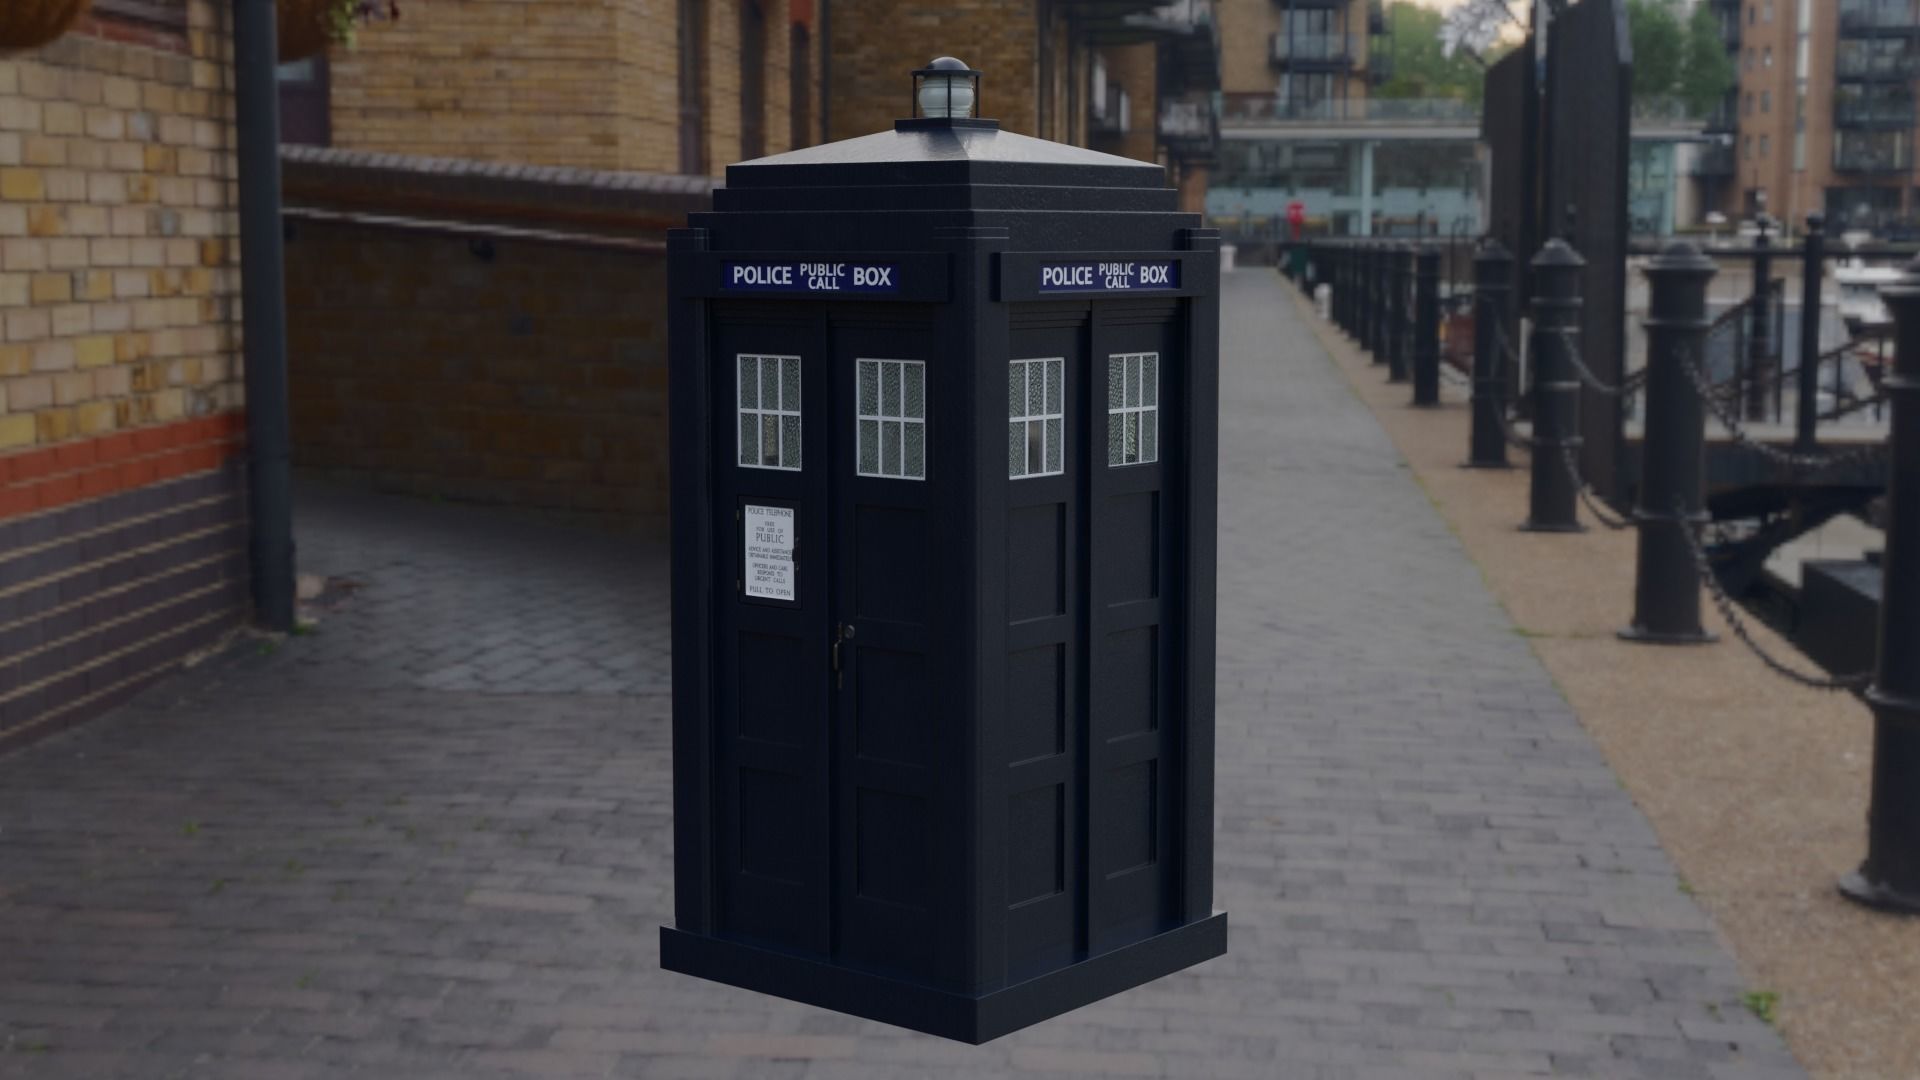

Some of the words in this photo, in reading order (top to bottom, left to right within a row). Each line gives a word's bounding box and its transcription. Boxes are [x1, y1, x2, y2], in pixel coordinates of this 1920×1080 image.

[733, 266, 792, 285] POLICE
[800, 263, 845, 277] PUBLIC
[853, 267, 892, 286] BOX
[1042, 266, 1093, 286] POLICE
[1098, 262, 1135, 276] PUBLIC
[1140, 265, 1169, 284] BOX
[808, 276, 840, 290] CALL
[1105, 275, 1131, 289] CALL
[747, 507, 764, 515] POLICE
[766, 508, 792, 518] TELEPHONE
[755, 531, 785, 544] PUBLIC
[749, 584, 763, 593] PULL
[765, 586, 774, 594] TO
[776, 588, 791, 597] OPEN
